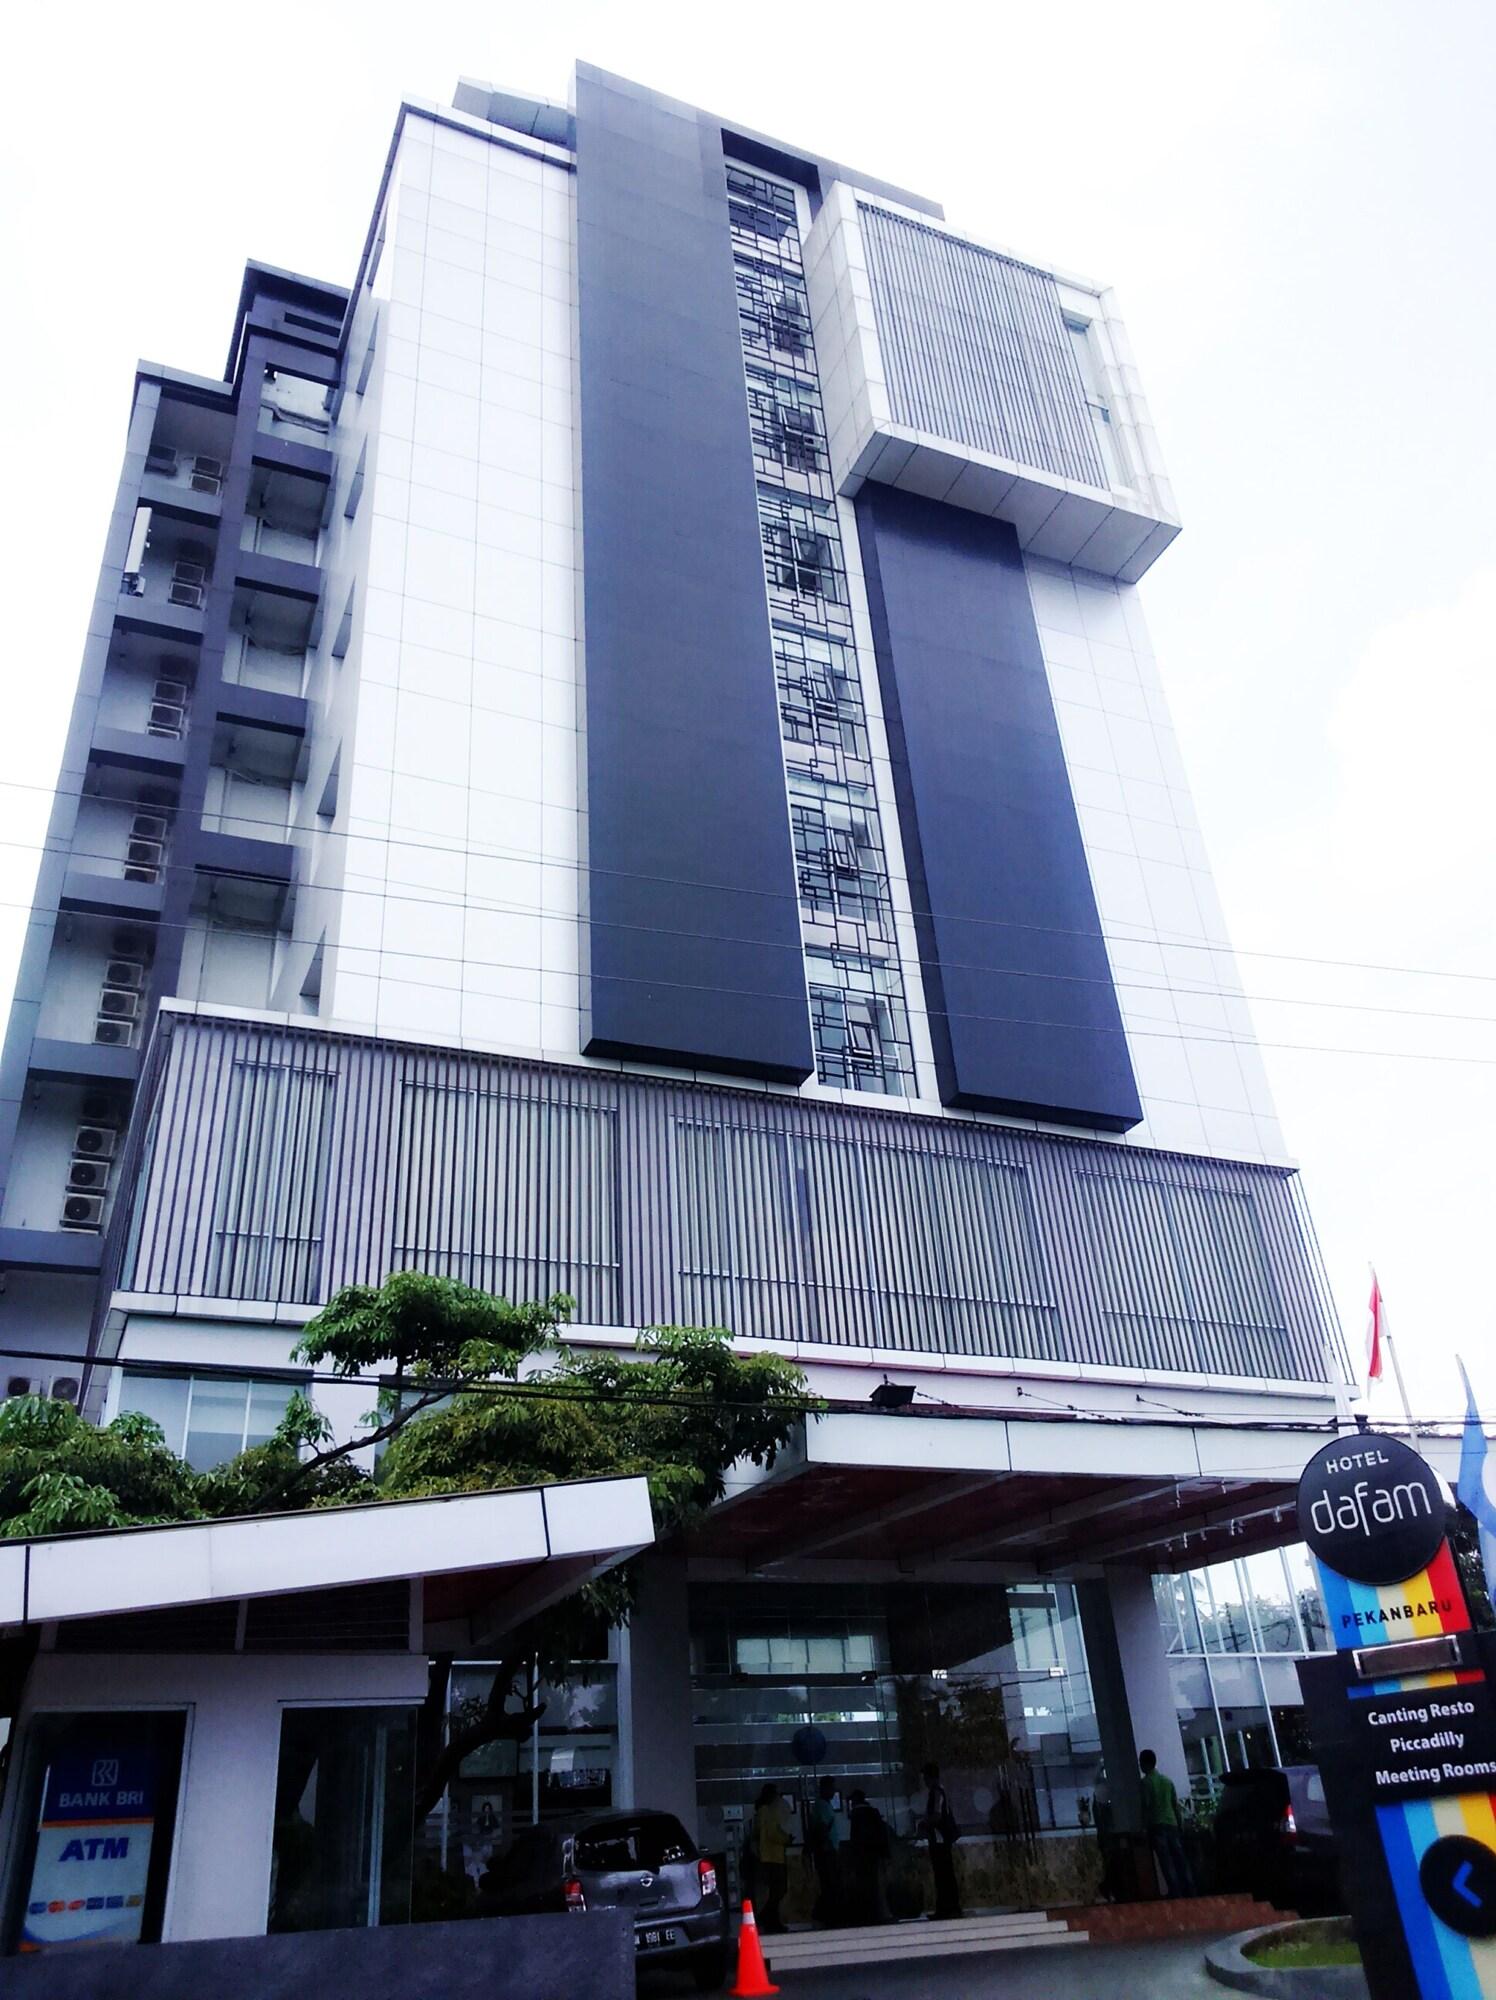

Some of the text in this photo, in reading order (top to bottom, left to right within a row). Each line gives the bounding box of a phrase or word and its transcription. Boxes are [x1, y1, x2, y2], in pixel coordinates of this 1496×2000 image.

[1326, 1450, 1389, 1474] HOTEL
[1310, 1481, 1432, 1537] dafam
[1341, 1601, 1453, 1629] PEKANBARU
[1368, 1702, 1475, 1725] Canting Resto
[1390, 1731, 1464, 1752] Piccadilly
[1375, 1762, 1496, 1785] Meeting Rooms
[59, 1791, 143, 1807] BANK BRI
[58, 1837, 130, 1862] ATM
